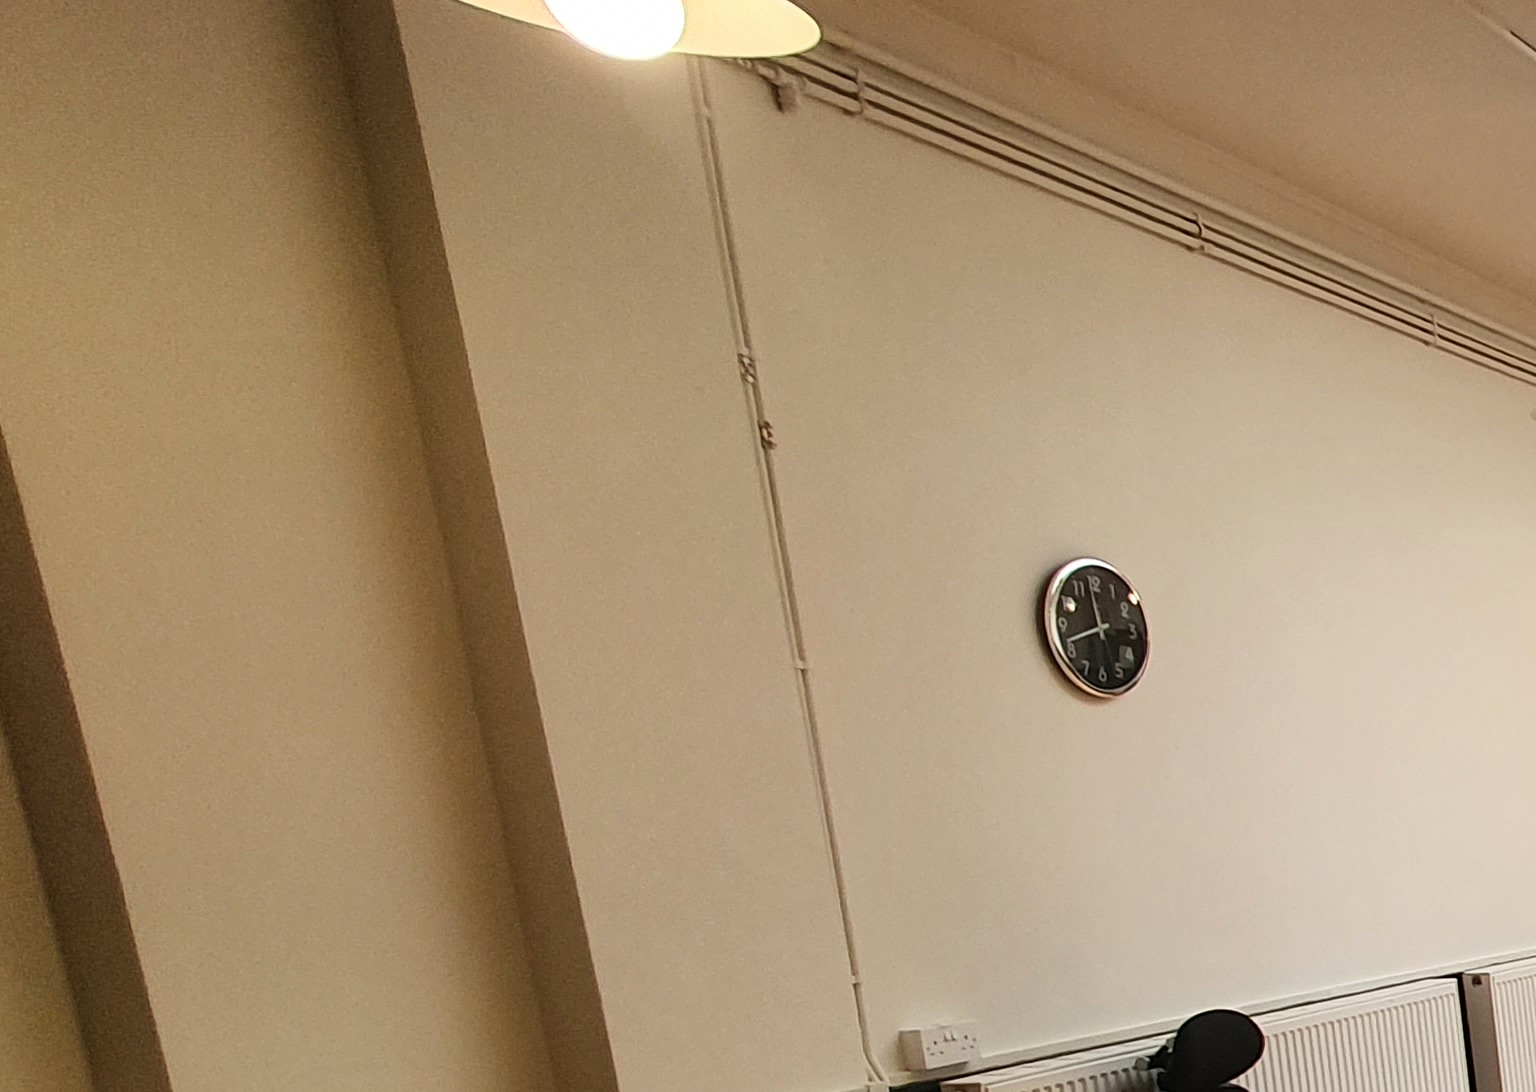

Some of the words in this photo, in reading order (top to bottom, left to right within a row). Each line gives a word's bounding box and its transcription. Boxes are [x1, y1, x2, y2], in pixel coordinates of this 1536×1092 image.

[1073, 579, 1085, 598] 11
[1109, 583, 1116, 601] 1
[1121, 602, 1130, 618] 2
[1058, 617, 1067, 632] 9
[1128, 623, 1137, 640] 3
[1067, 642, 1076, 658] 8
[1125, 647, 1135, 666] 4
[1081, 660, 1090, 676] 7
[1098, 666, 1107, 682] 6
[1115, 662, 1124, 680] 5
